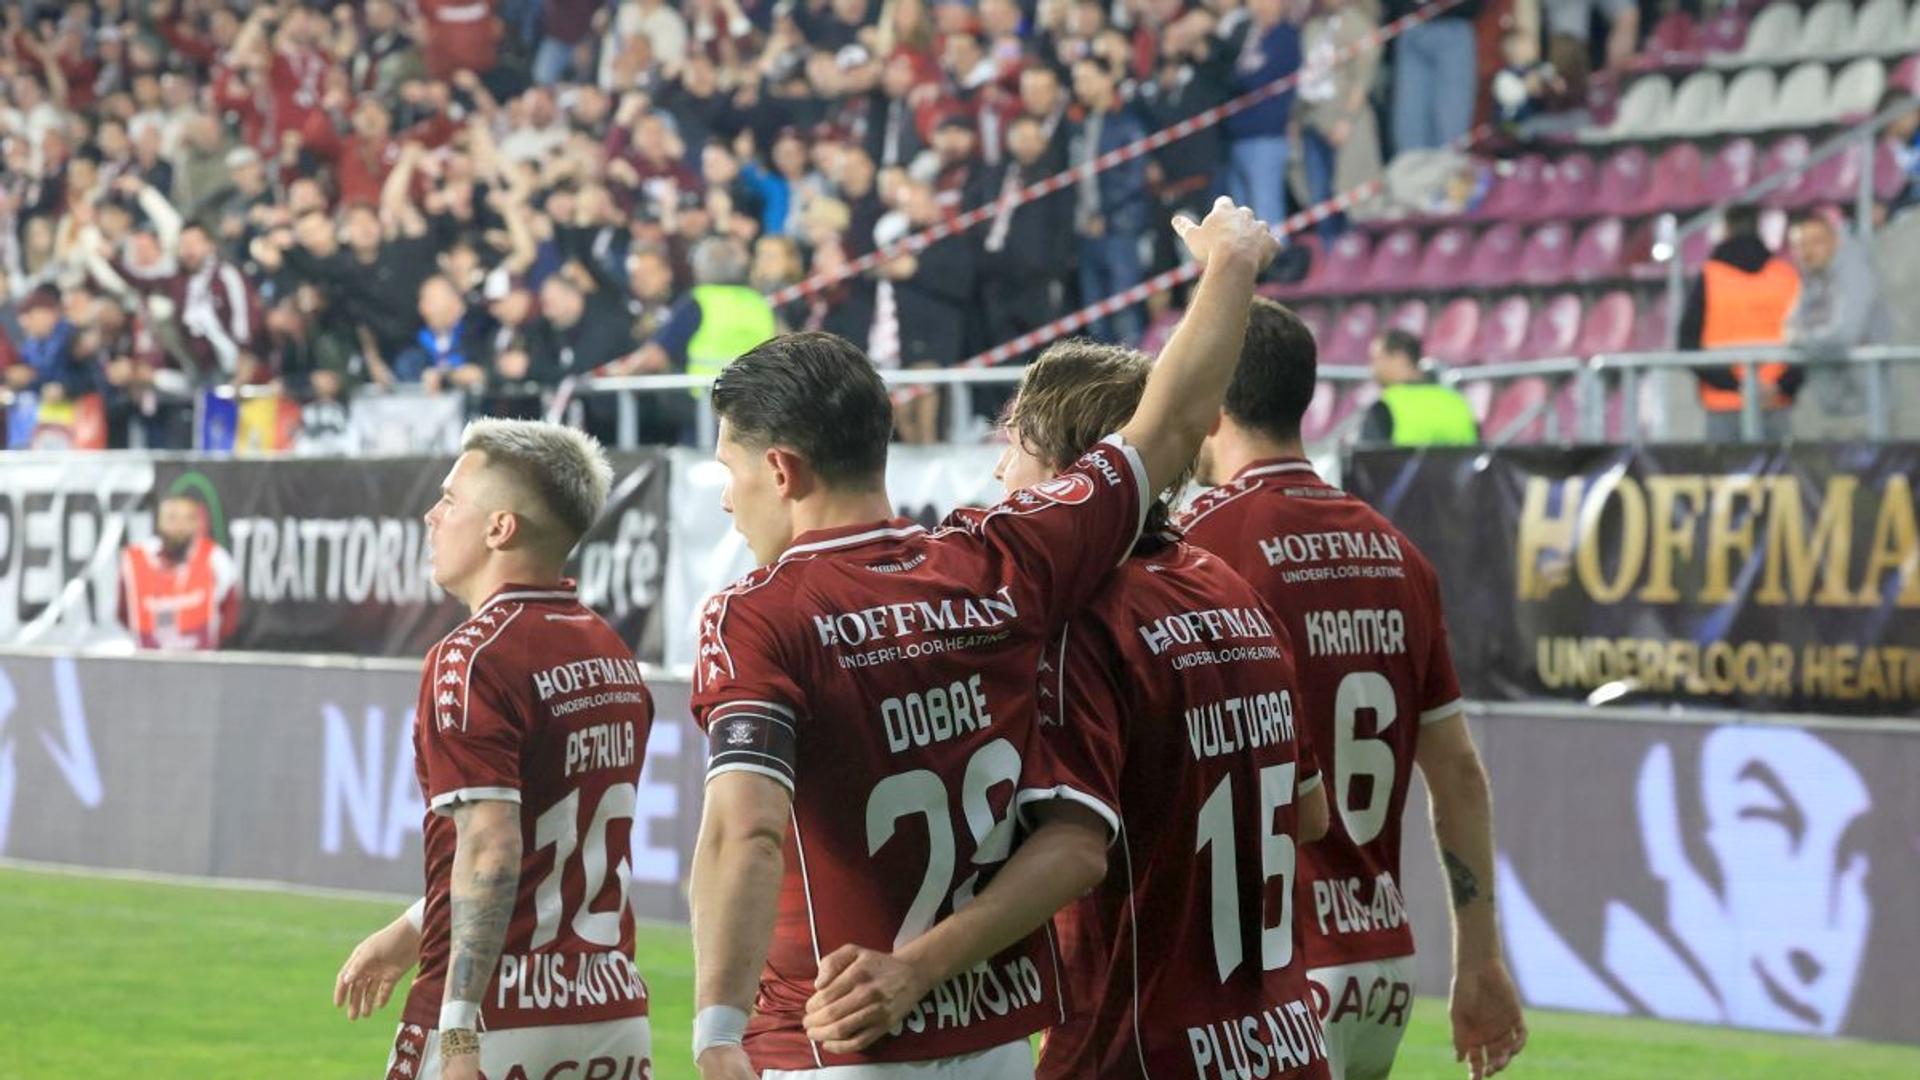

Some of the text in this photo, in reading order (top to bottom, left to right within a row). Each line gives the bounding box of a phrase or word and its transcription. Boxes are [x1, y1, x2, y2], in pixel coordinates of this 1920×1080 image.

[1258, 531, 1404, 566] HOFFMAN
[1282, 566, 1360, 583] UNDERFLOOR
[812, 587, 1018, 647] HOFFMAN
[1304, 608, 1406, 657] KRAMER
[533, 657, 641, 701] HOFFMAN
[837, 639, 944, 670] UNDERFLOOR
[1537, 637, 1794, 697] UNDERFLOOR
[881, 673, 991, 754] DOBRE
[564, 720, 635, 777] PETRILA
[1334, 671, 1398, 846] 6
[531, 782, 638, 950] 10
[1195, 761, 1296, 985] 15
